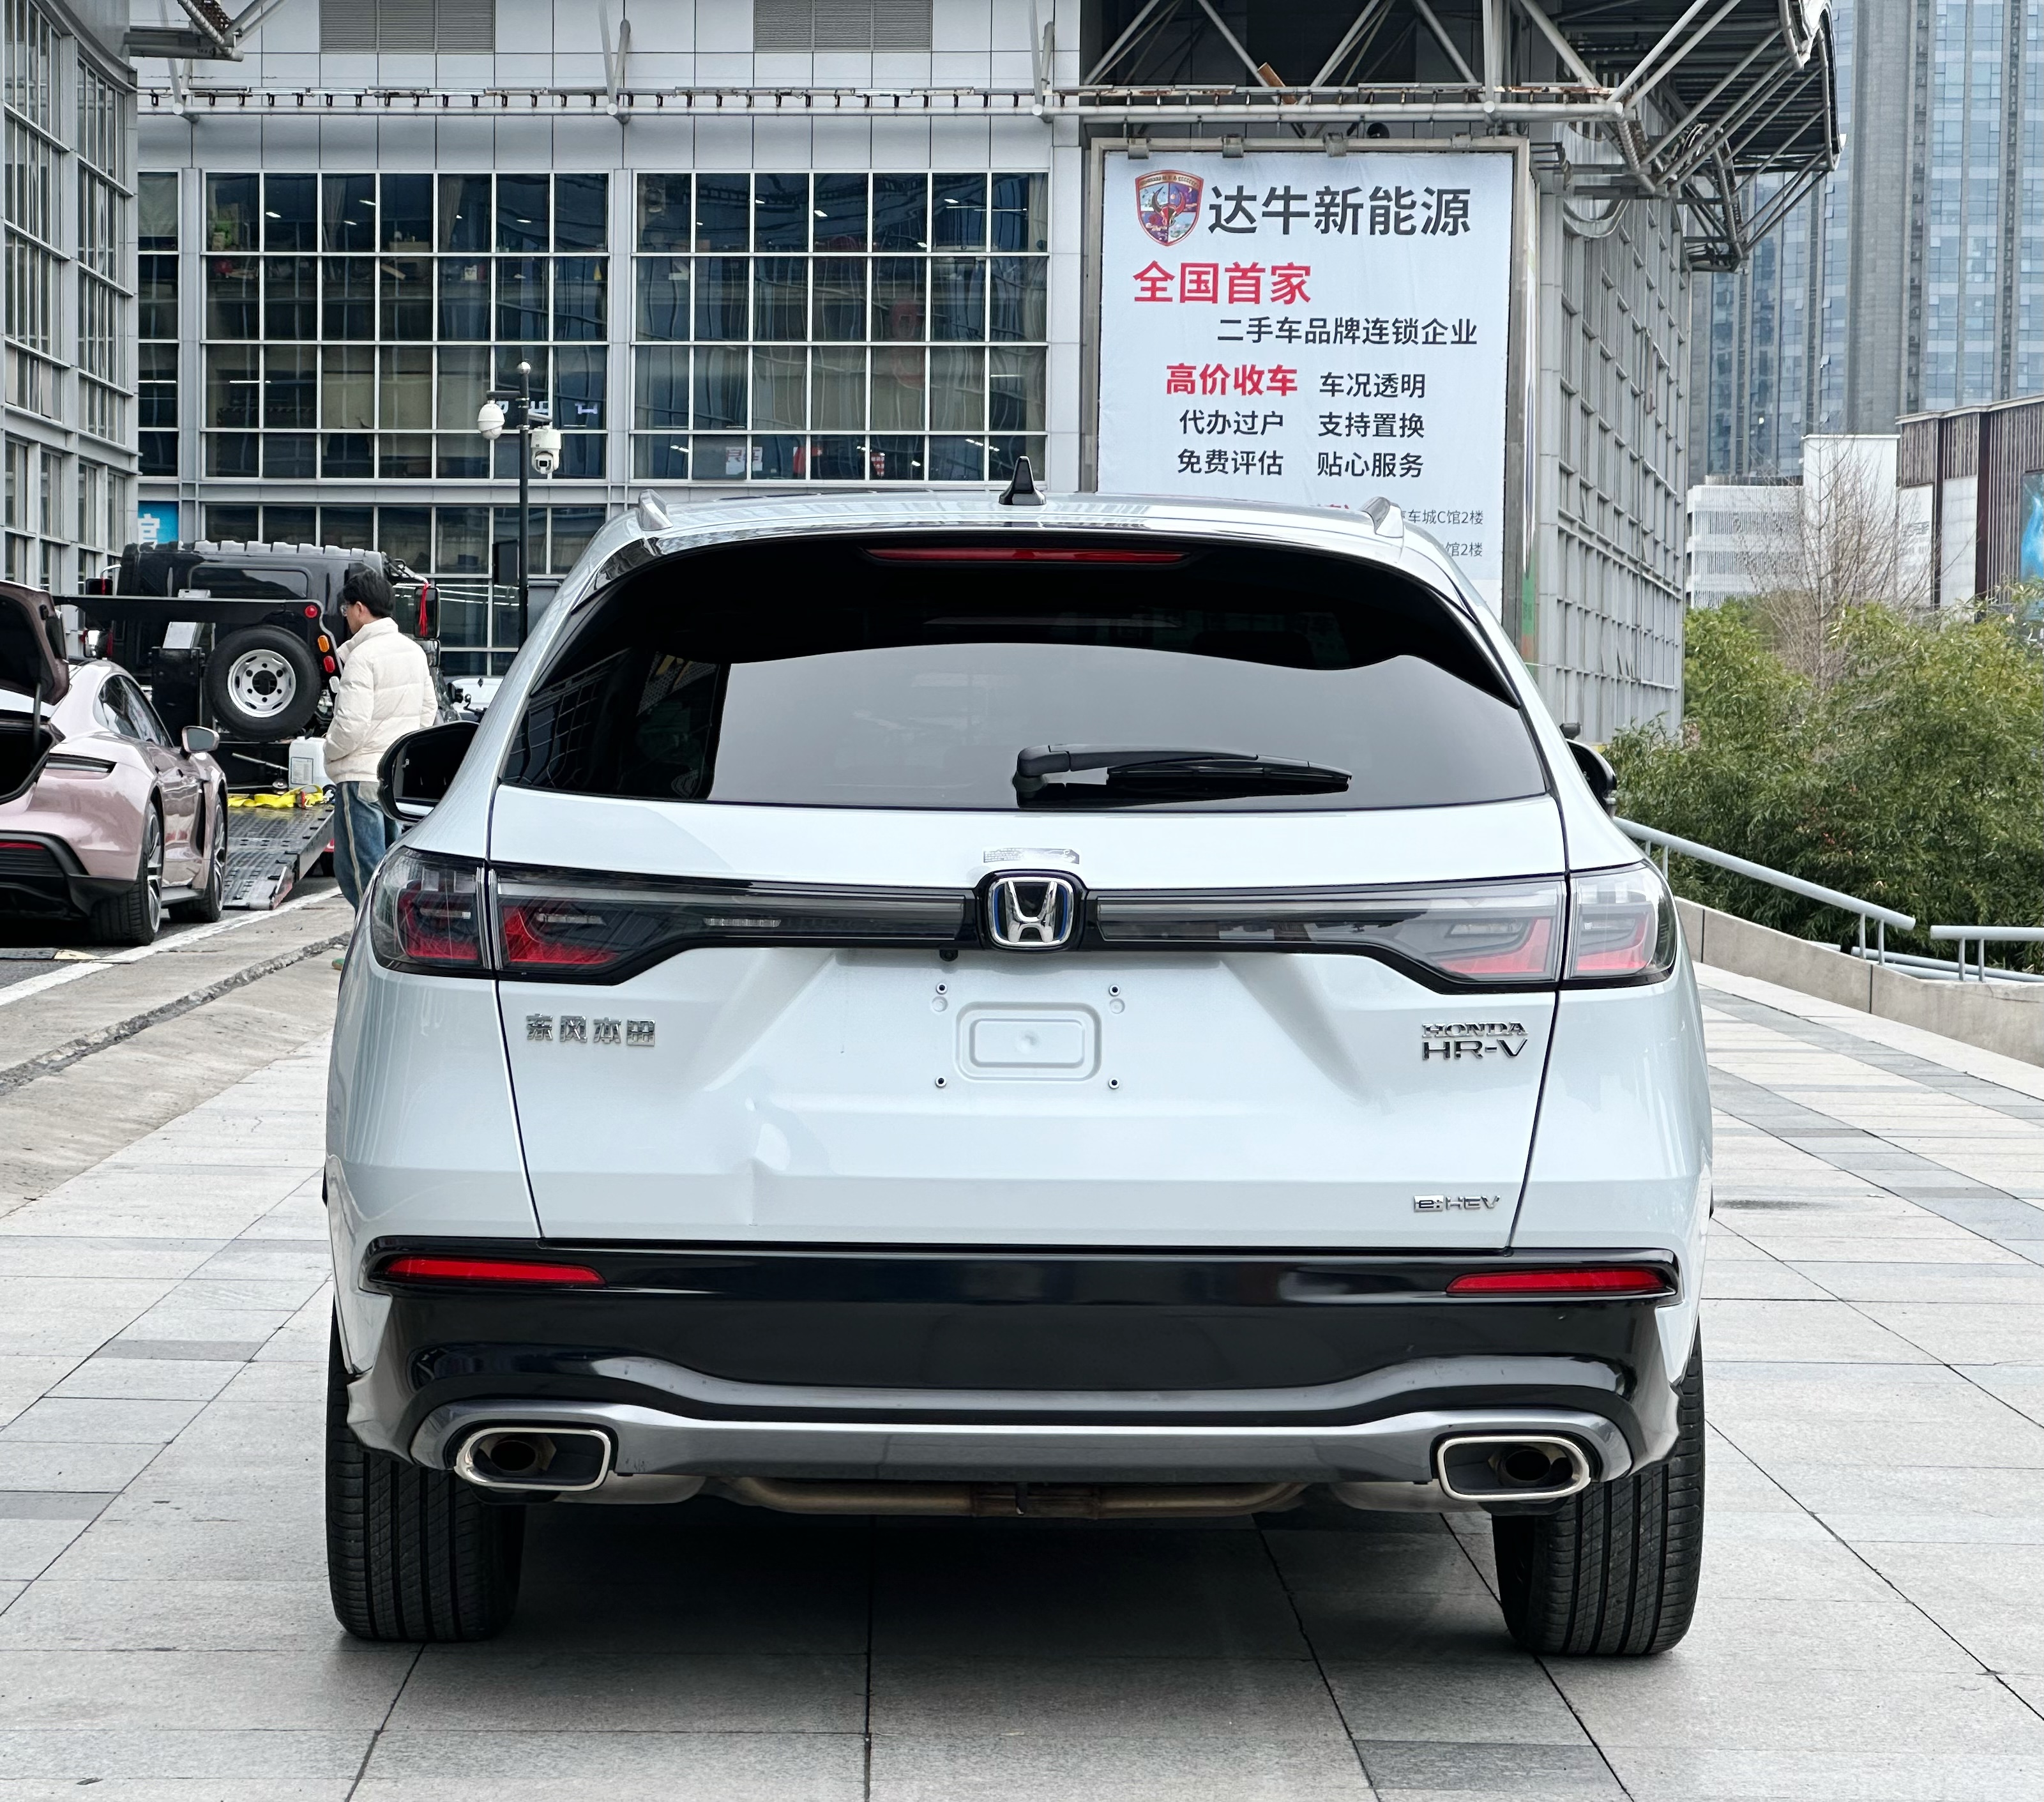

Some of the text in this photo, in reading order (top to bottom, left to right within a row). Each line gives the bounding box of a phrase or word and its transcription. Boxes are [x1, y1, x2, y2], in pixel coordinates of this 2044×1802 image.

[1207, 185, 1471, 236] 达牛新能源
[1132, 260, 1311, 305] 全国首家
[1217, 316, 1478, 345] 二手车品牌连锁企业
[1166, 363, 1298, 397] 高价收车
[1319, 372, 1425, 399] 车况透明
[1179, 409, 1283, 436] 代办过户
[1317, 411, 1425, 439] 支持置换
[1177, 448, 1284, 476] 免费评估
[1317, 451, 1424, 478] 贴心服务
[1402, 510, 1484, 526] 车城C馆2楼
[526, 1013, 656, 1047] 东风本田
[1421, 1021, 1529, 1039] HONDA
[1421, 1038, 1529, 1061] HR-V
